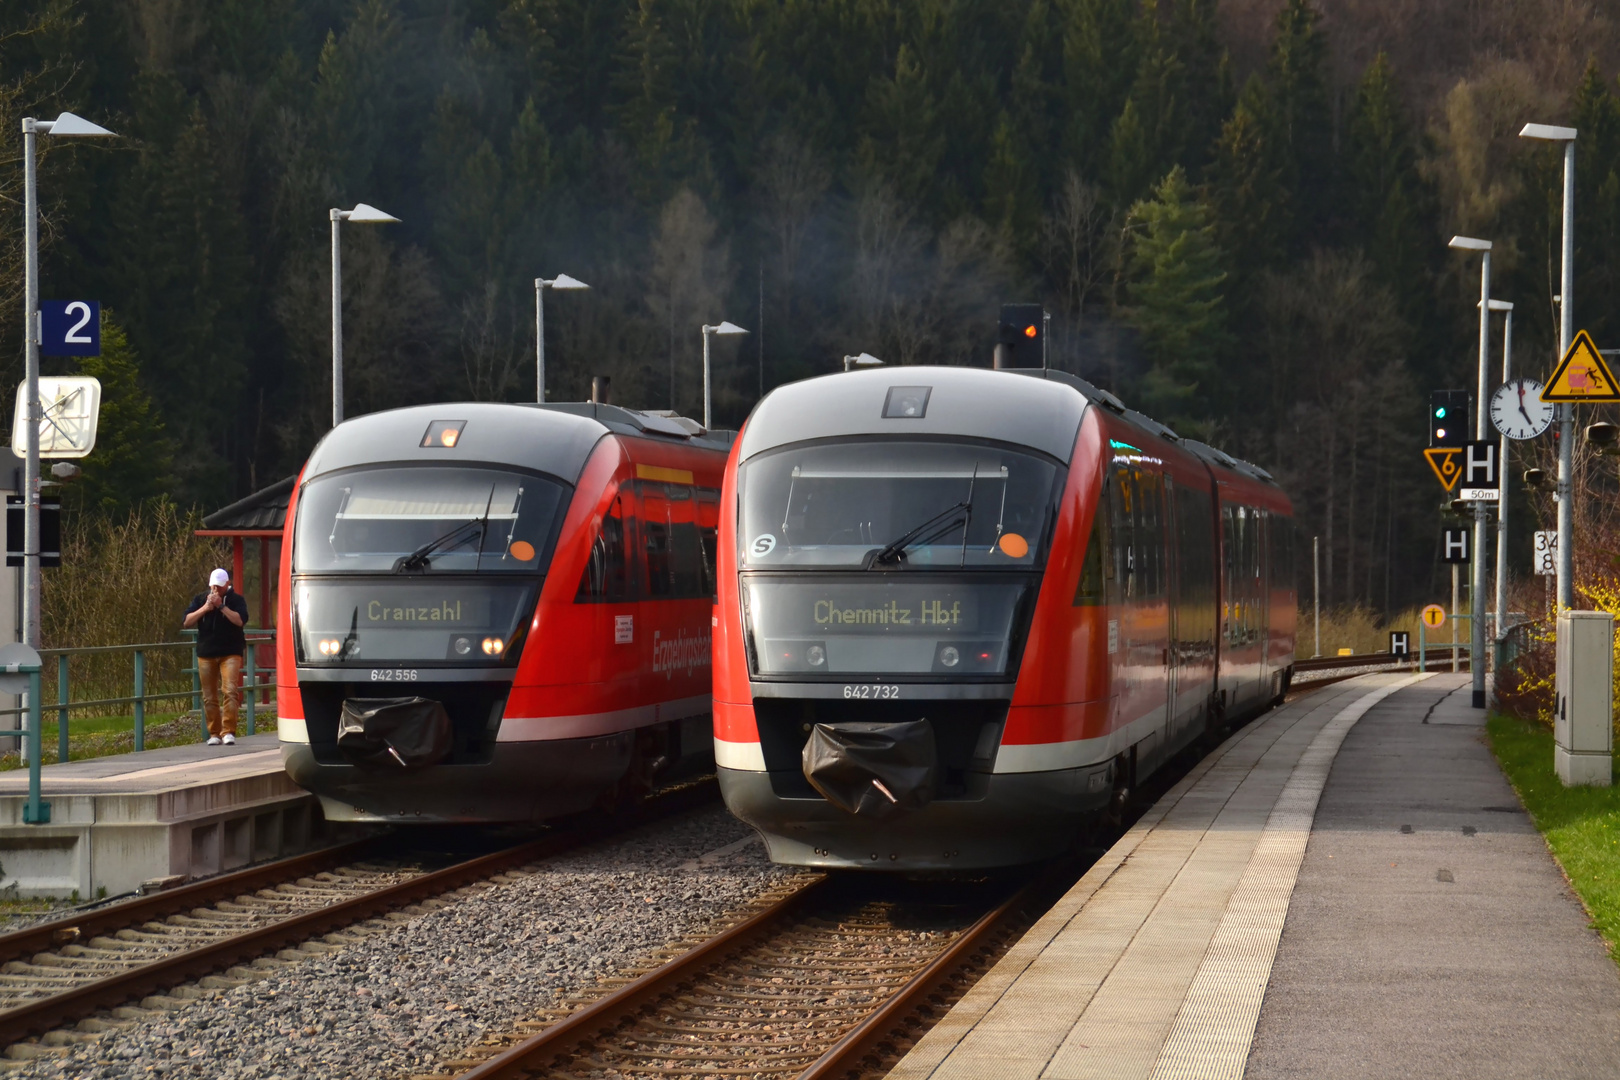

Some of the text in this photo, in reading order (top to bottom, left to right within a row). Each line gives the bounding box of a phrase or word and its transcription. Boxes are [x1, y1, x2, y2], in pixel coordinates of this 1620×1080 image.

[64, 301, 92, 344] 2
[1441, 451, 1456, 476] 6
[1466, 444, 1494, 483] H
[1471, 490, 1494, 499] 50m
[1445, 530, 1467, 559] H
[1536, 534, 1558, 551] 34
[1542, 553, 1553, 570] 8
[368, 600, 461, 621] Cranzahl
[814, 600, 960, 624] Chemnitz Hbf
[1391, 633, 1407, 655] H
[370, 669, 418, 681] 642 556
[843, 685, 899, 699] 642 732
